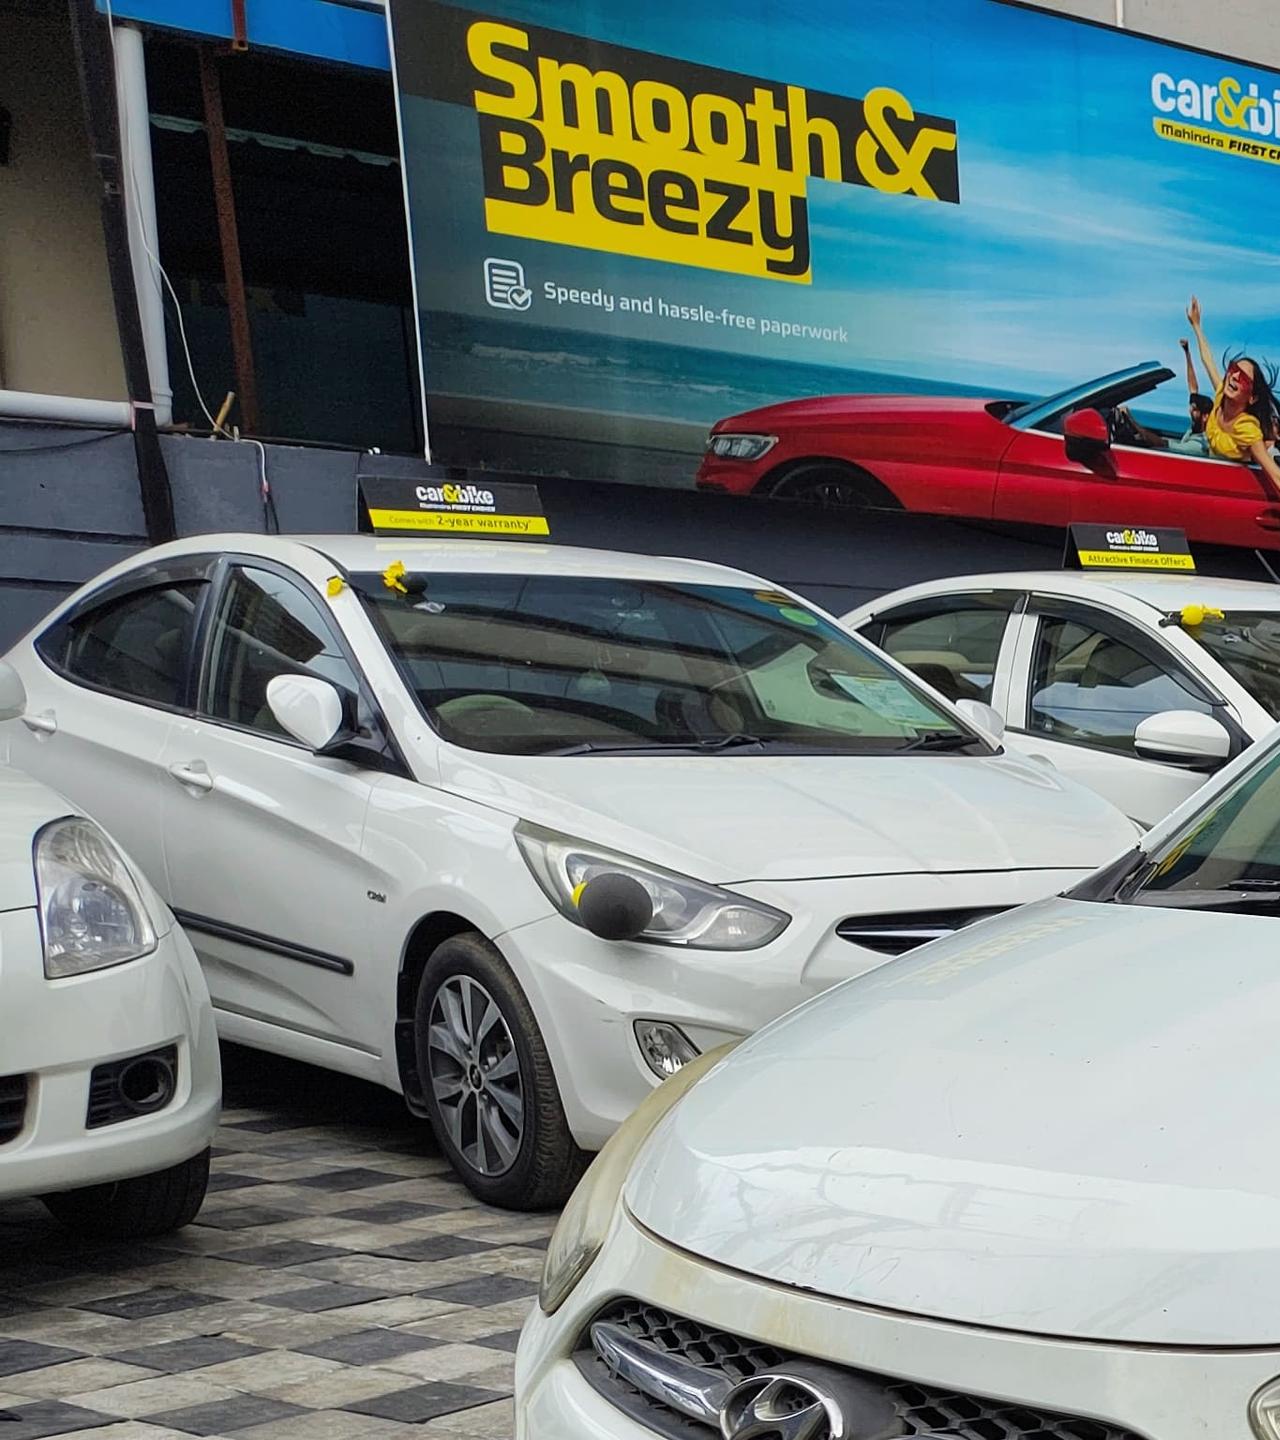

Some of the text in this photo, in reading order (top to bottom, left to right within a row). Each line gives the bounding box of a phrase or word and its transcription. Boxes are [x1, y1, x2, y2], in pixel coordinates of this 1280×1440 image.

[466, 21, 957, 200] Smooth &
[1161, 123, 1225, 148] Mahindra
[1228, 139, 1268, 157] FIRST
[479, 118, 810, 275] Breezy
[543, 281, 848, 344] Speedy and hassle-free paperwork
[416, 483, 494, 505] car&bike
[436, 514, 474, 528] 2-year
[1106, 529, 1157, 546] car&bike
[1088, 554, 1129, 564] Attractive
[1130, 556, 1158, 565] Finance
